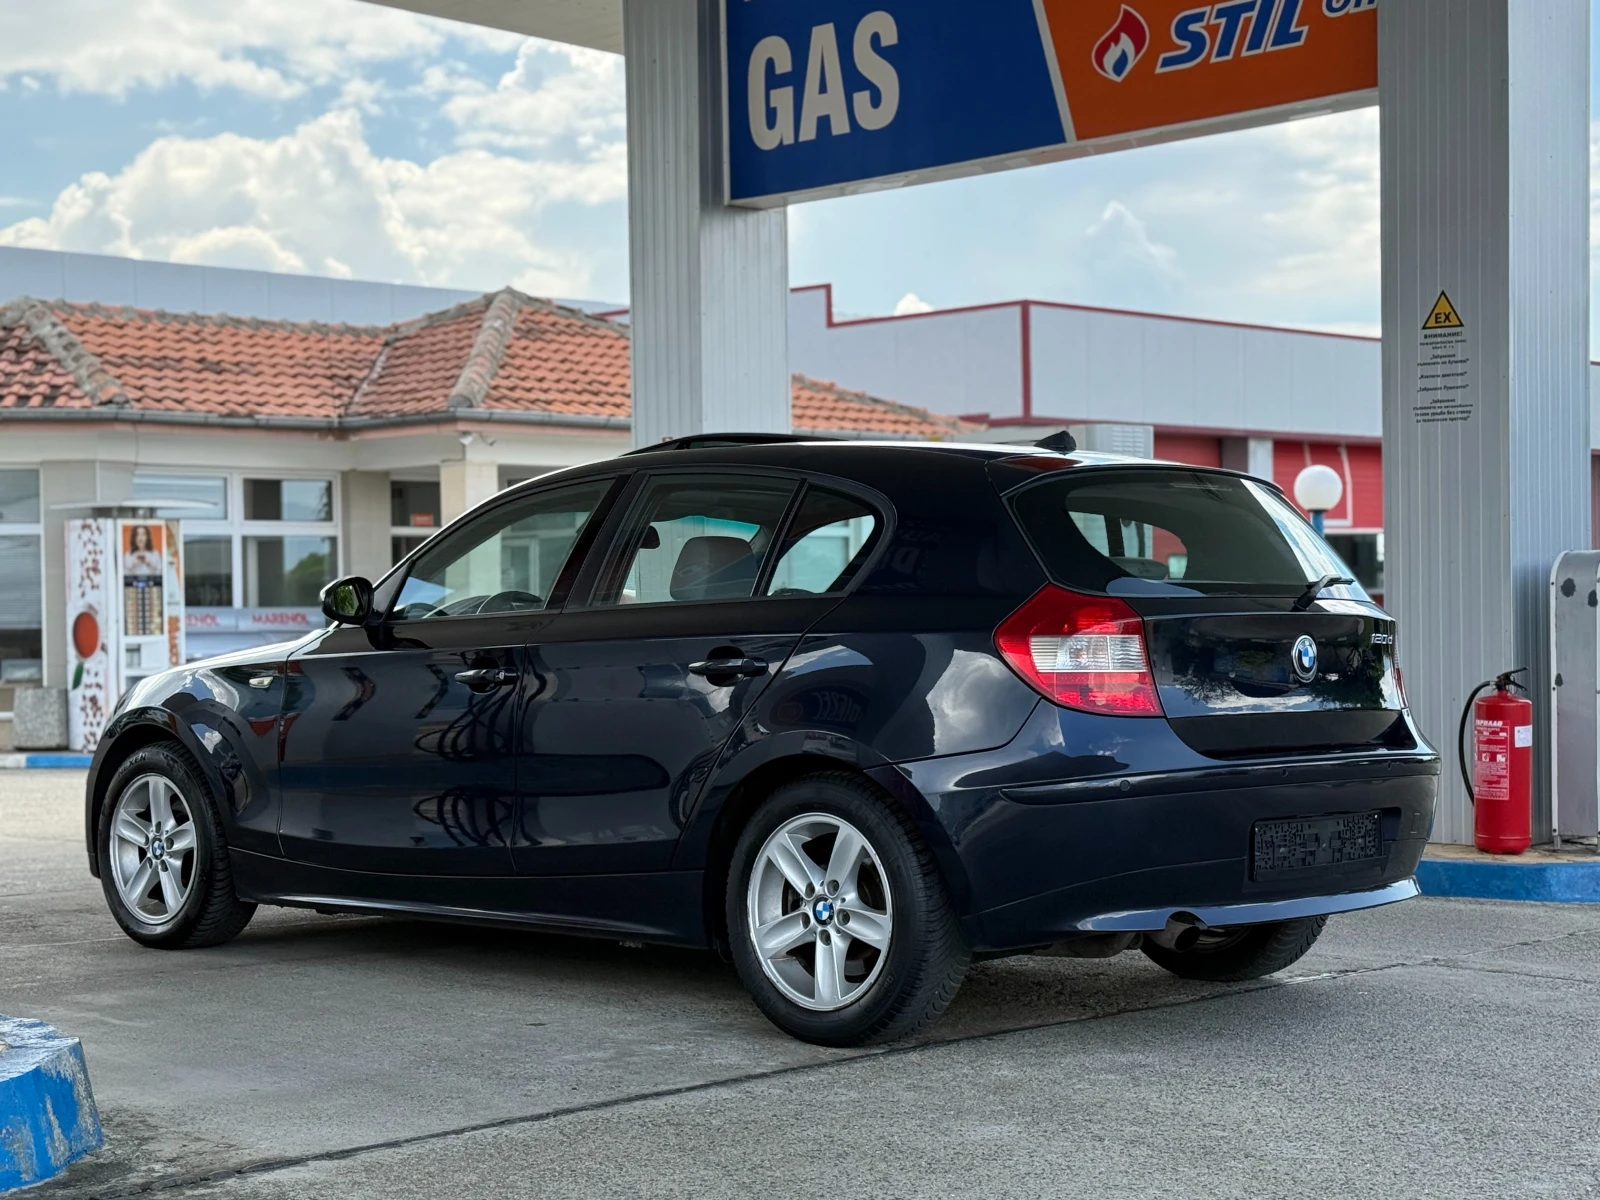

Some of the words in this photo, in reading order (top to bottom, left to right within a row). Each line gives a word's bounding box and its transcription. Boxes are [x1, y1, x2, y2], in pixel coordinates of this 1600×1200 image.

[1154, 0, 1308, 75] STIL
[748, 10, 900, 151] GAS
[1423, 331, 1463, 340] ВНИМАНИЕ!
[1434, 311, 1452, 325] EX
